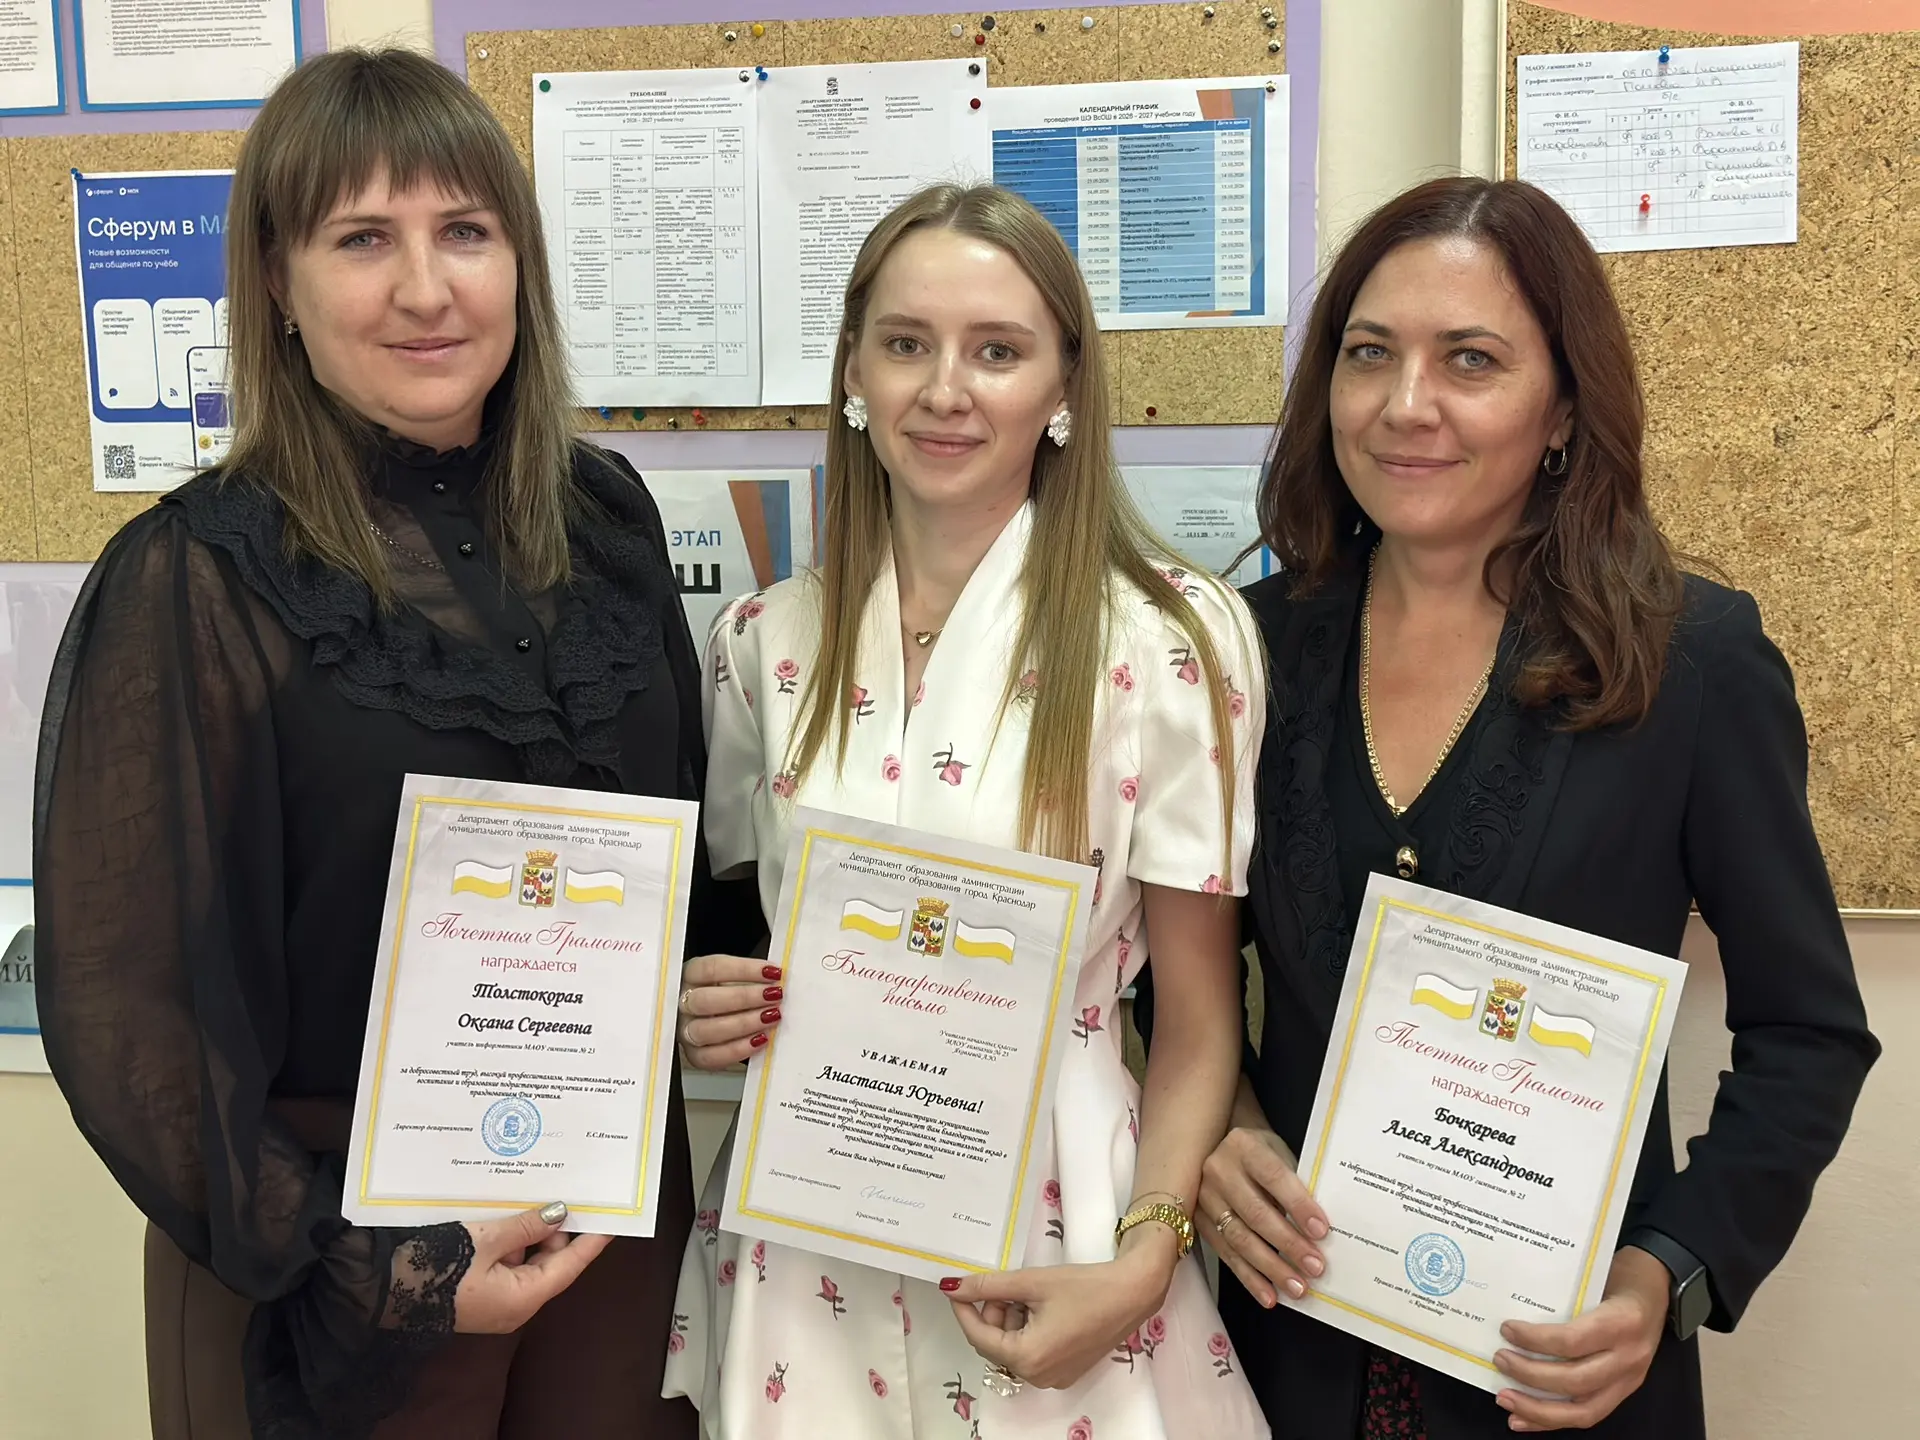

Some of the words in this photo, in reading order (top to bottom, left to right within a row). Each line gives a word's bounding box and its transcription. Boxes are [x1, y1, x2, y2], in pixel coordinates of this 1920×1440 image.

[1044, 115, 1079, 124] проведения
[1081, 114, 1092, 122] ШЭ
[1155, 111, 1181, 119] учебном
[1080, 105, 1131, 113] КАЛЕНДАРНЫЙ
[1132, 103, 1159, 111] ГРАФИК
[88, 217, 176, 242] Сферум
[182, 220, 195, 235] в
[89, 261, 104, 270] для
[105, 261, 141, 270] общения
[155, 260, 179, 270] учёбе
[116, 248, 170, 256] возможности
[671, 530, 721, 546] ЭТАП
[447, 825, 513, 836] муниципального
[516, 829, 568, 841] образования
[571, 835, 595, 845] город
[598, 836, 642, 850] Краснодар
[456, 813, 509, 826] Департамент
[512, 818, 564, 830] образования
[567, 825, 630, 837] администрации
[838, 861, 905, 881] муниципального
[908, 876, 961, 893] образования
[964, 888, 988, 899] город
[992, 892, 1036, 911] Краснодар
[848, 851, 902, 870] Департамент
[905, 864, 957, 881] образования
[961, 877, 1024, 896] администрации
[421, 912, 532, 943] Почетная
[536, 921, 642, 955] Грамота
[480, 956, 576, 972] награждается
[1412, 933, 1482, 959] муниципального
[1485, 954, 1540, 976] образования
[1543, 972, 1568, 986] город
[1572, 979, 1619, 1002] Краснодар
[1423, 924, 1480, 946] Департамент
[1482, 942, 1538, 964] образования
[1540, 960, 1608, 986] администрации
[821, 949, 1018, 1011] Благодарственное
[471, 982, 583, 1007] Толстокорая
[882, 991, 948, 1016] письмо
[457, 1013, 514, 1032] Оксана
[517, 1016, 592, 1037] Сергеевна
[475, 1041, 523, 1050] информатики
[524, 1043, 545, 1051] МАОУ
[861, 1049, 947, 1076] УВАЖАЕМАЯ
[1375, 1021, 1488, 1073] Почетная
[1491, 1058, 1604, 1111] Грамота
[815, 1065, 904, 1095] Анастасия
[905, 1084, 984, 1113] Юрьевна!
[1431, 1075, 1530, 1117] награждается
[787, 1101, 836, 1119] добросовестный
[837, 1114, 854, 1124] труд,
[855, 1119, 881, 1129] высокий
[802, 1096, 840, 1110] образования
[841, 1106, 859, 1115] город
[859, 1109, 892, 1124] Краснодар
[892, 1118, 925, 1130] выражает
[926, 1124, 940, 1133] Вам
[803, 1087, 848, 1103] Департамент
[848, 1098, 886, 1112] образования
[887, 1106, 937, 1123] администрации
[937, 1119, 989, 1135] муниципального
[392, 1123, 425, 1131] Директор
[794, 1114, 830, 1126] воспитание
[836, 1121, 874, 1136] образование
[874, 1132, 922, 1147] подрастающего
[966, 1153, 983, 1162] связи
[1434, 1107, 1516, 1145] Бочкарева
[844, 1134, 891, 1149] празднованием
[891, 1144, 906, 1152] Дня
[1382, 1119, 1431, 1146] Алеся
[1430, 1136, 1554, 1188] Александровна
[827, 1147, 852, 1158] Желаем
[853, 1153, 867, 1161] Вам
[868, 1156, 895, 1168] здоровья
[494, 1167, 524, 1175] Краснодар
[768, 1168, 797, 1181] Директор
[1396, 1152, 1425, 1165] учитель
[1426, 1162, 1451, 1174] музыки
[1452, 1169, 1473, 1182] МАОУ
[1474, 1179, 1507, 1194] гимназии
[1516, 1192, 1526, 1200] 23
[1327, 1223, 1353, 1238] иректор
[1353, 1234, 1399, 1255] департамента
